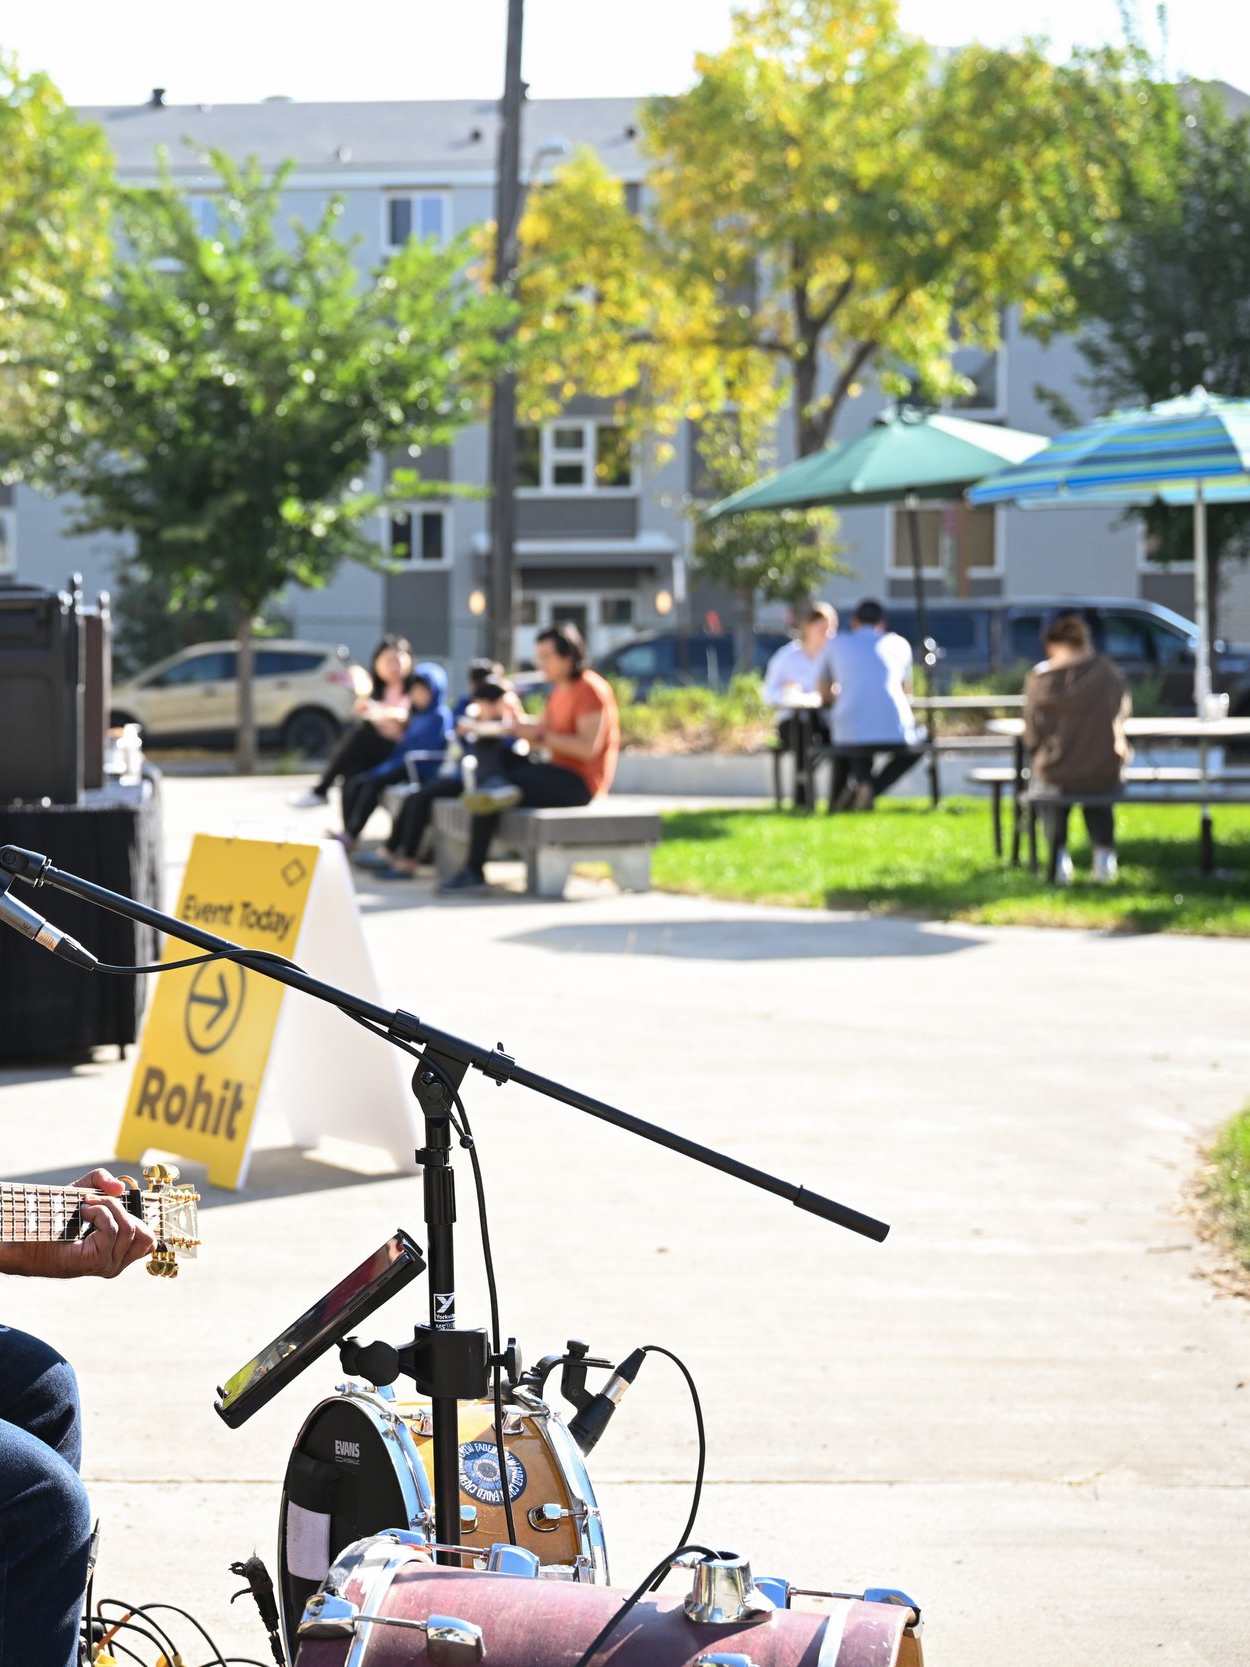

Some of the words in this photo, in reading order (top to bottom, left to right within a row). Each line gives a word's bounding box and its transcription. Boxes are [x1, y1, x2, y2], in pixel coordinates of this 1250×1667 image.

[182, 896, 234, 925] Event
[240, 902, 293, 940] Today
[135, 1066, 244, 1141] Rohit
[335, 1440, 360, 1458] EVANS
[504, 1451, 520, 1467] REW
[511, 1467, 524, 1488] FADED
[476, 1489, 500, 1502] FADED
